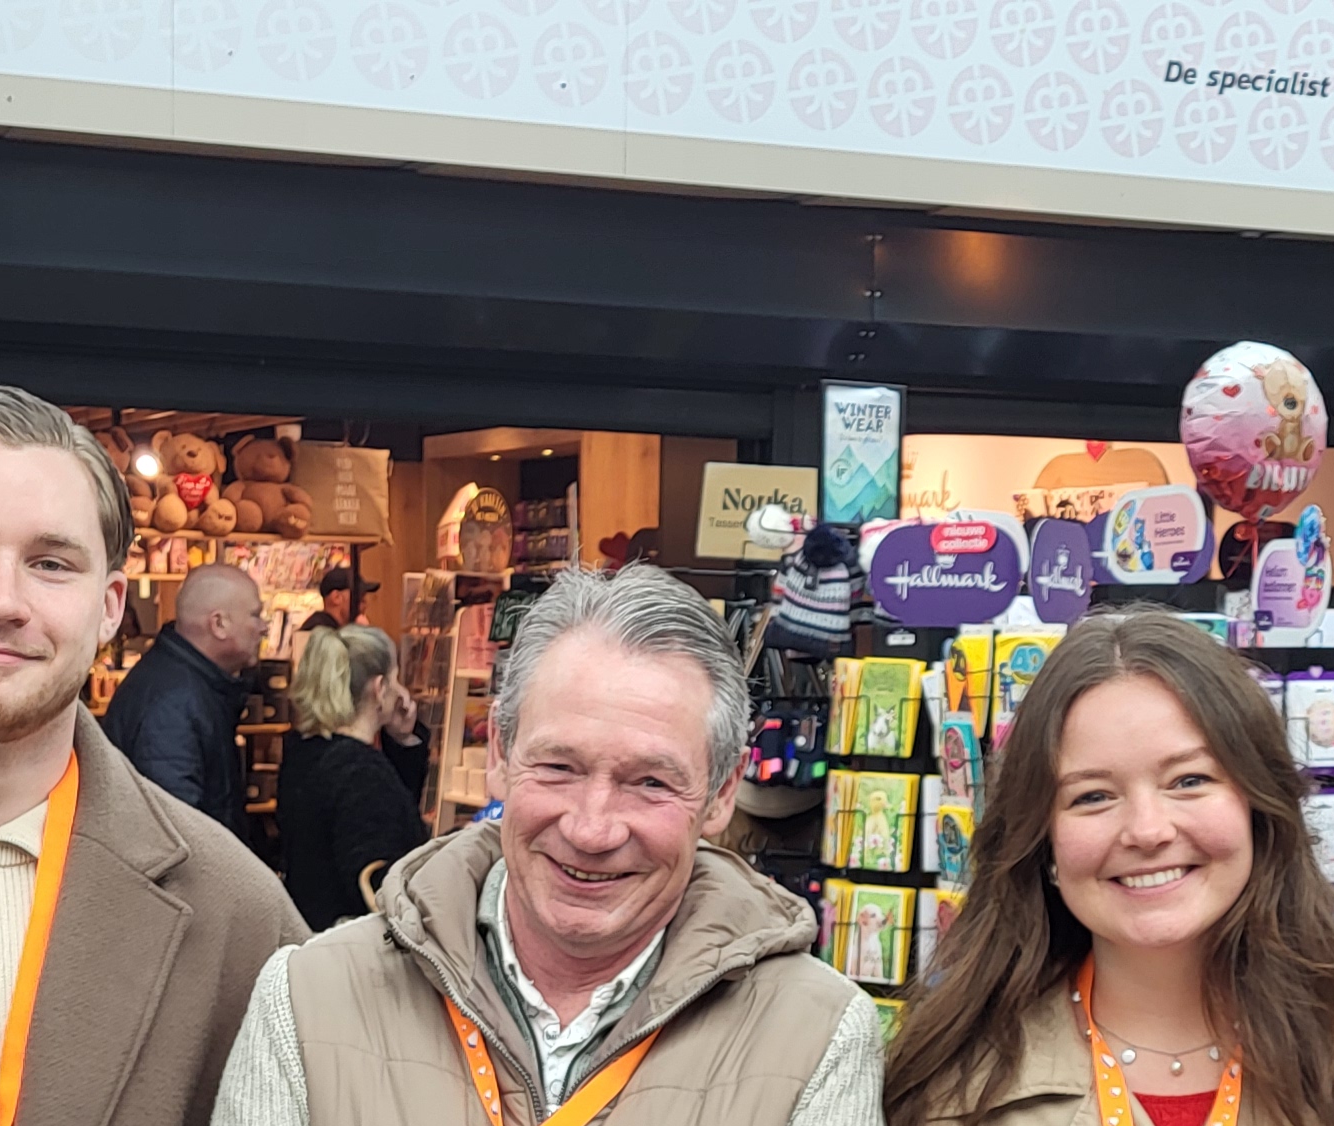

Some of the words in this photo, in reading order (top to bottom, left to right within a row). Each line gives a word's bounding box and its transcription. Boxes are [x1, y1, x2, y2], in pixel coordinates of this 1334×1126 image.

[1164, 60, 1198, 84] De
[1206, 68, 1331, 98] specialist
[834, 401, 892, 420] WINTER
[841, 417, 885, 433] WEAR
[939, 538, 989, 549] collectie
[884, 560, 1008, 601] Hallmark
